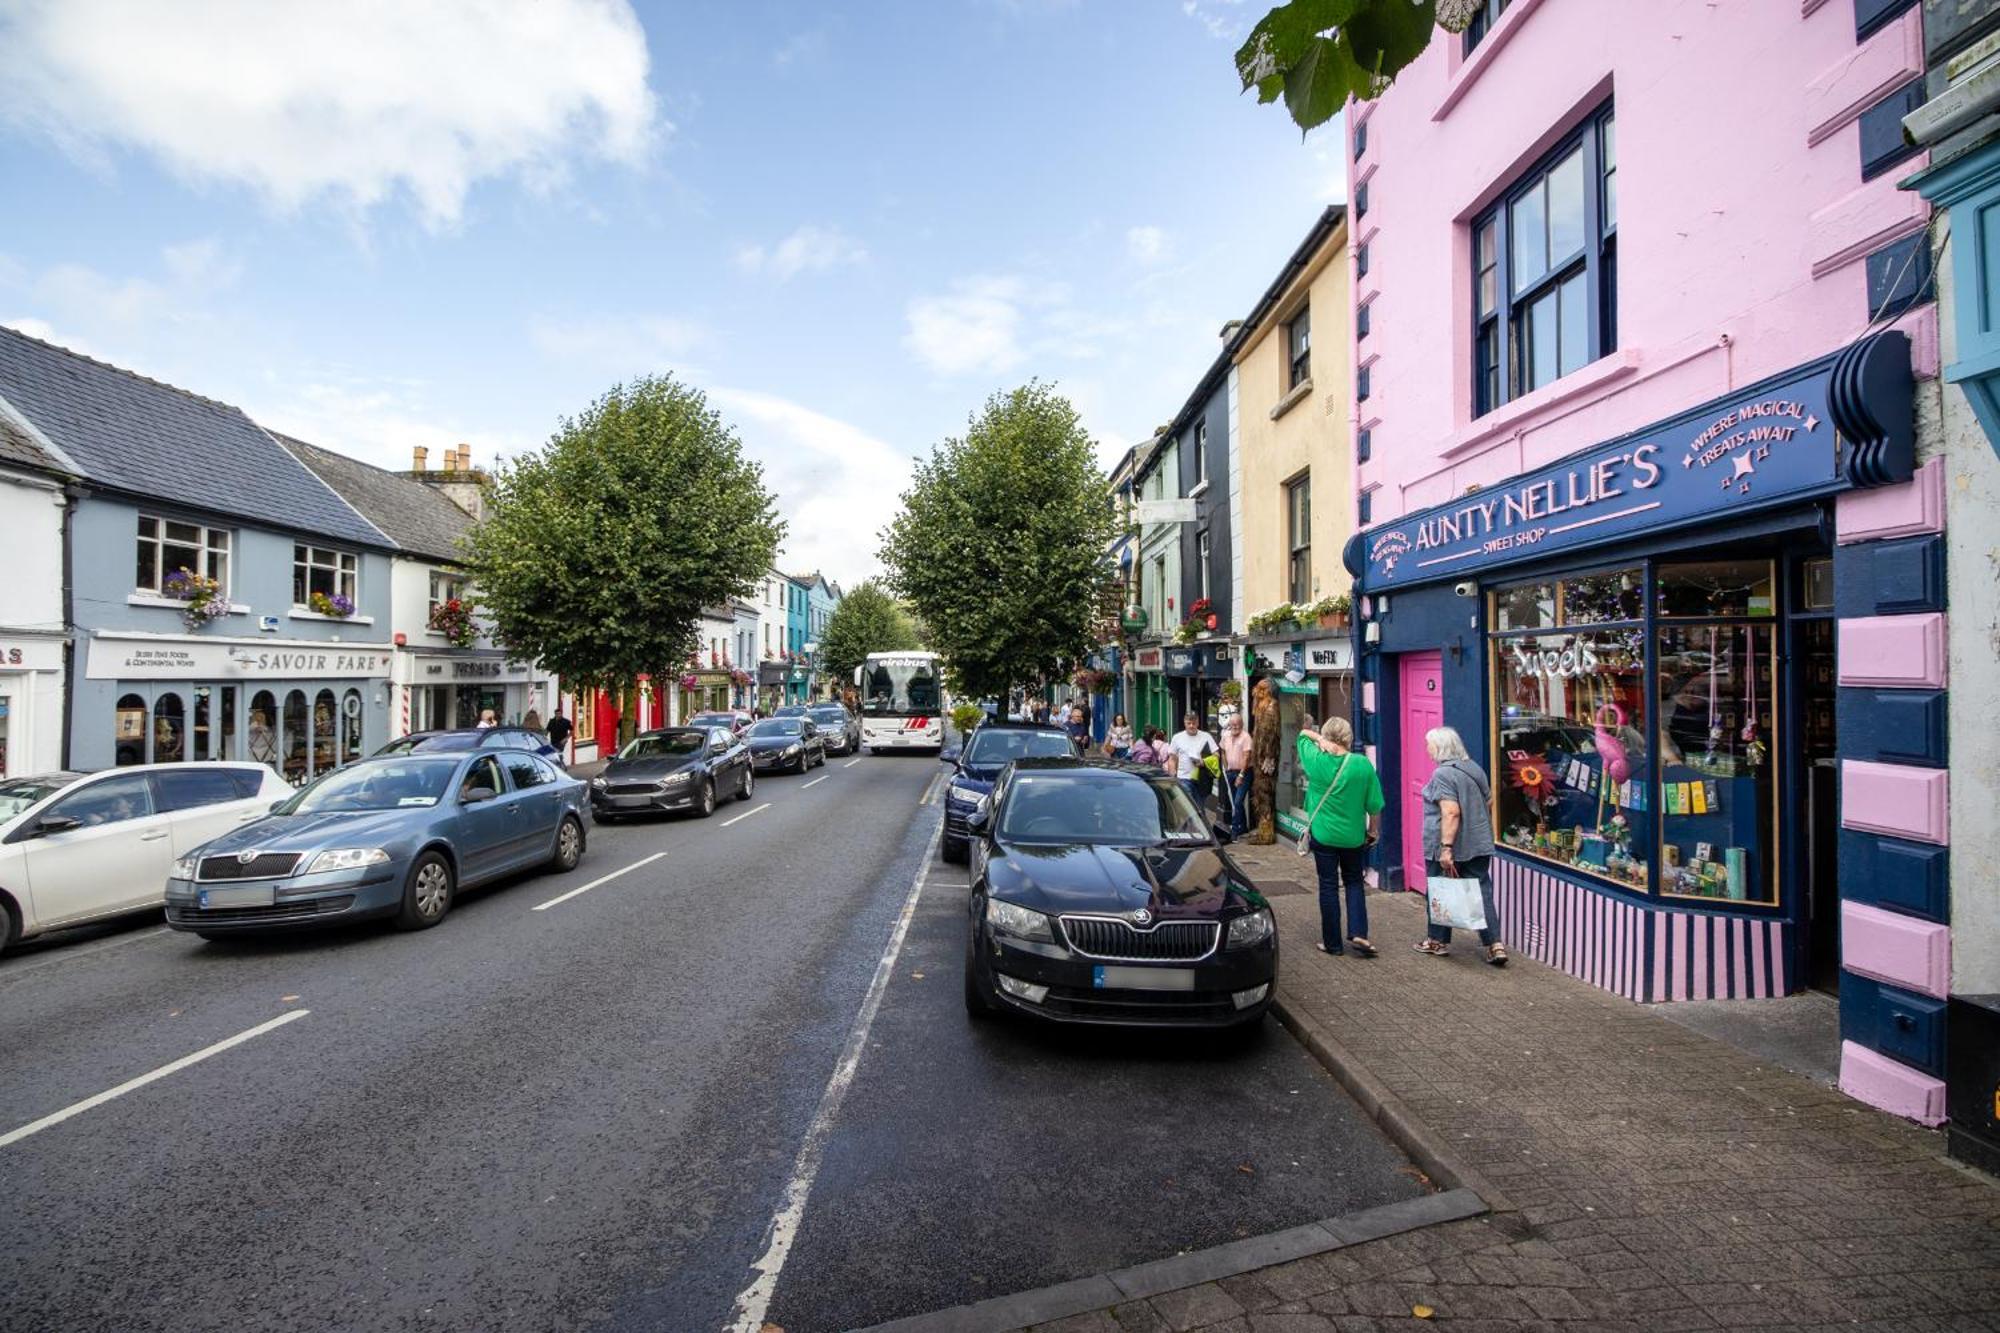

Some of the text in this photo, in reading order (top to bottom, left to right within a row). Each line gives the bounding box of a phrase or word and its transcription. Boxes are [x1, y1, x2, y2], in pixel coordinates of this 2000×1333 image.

[1690, 400, 1804, 452] WHERE MAGICAL
[1697, 426, 1799, 468] TREATS AWAIT
[1416, 443, 1662, 551] AUNTY NELLIE'S
[1483, 527, 1546, 554] SWEET SHOP
[258, 653, 376, 671] SAVOIR FARE
[879, 658, 928, 667] eirebus
